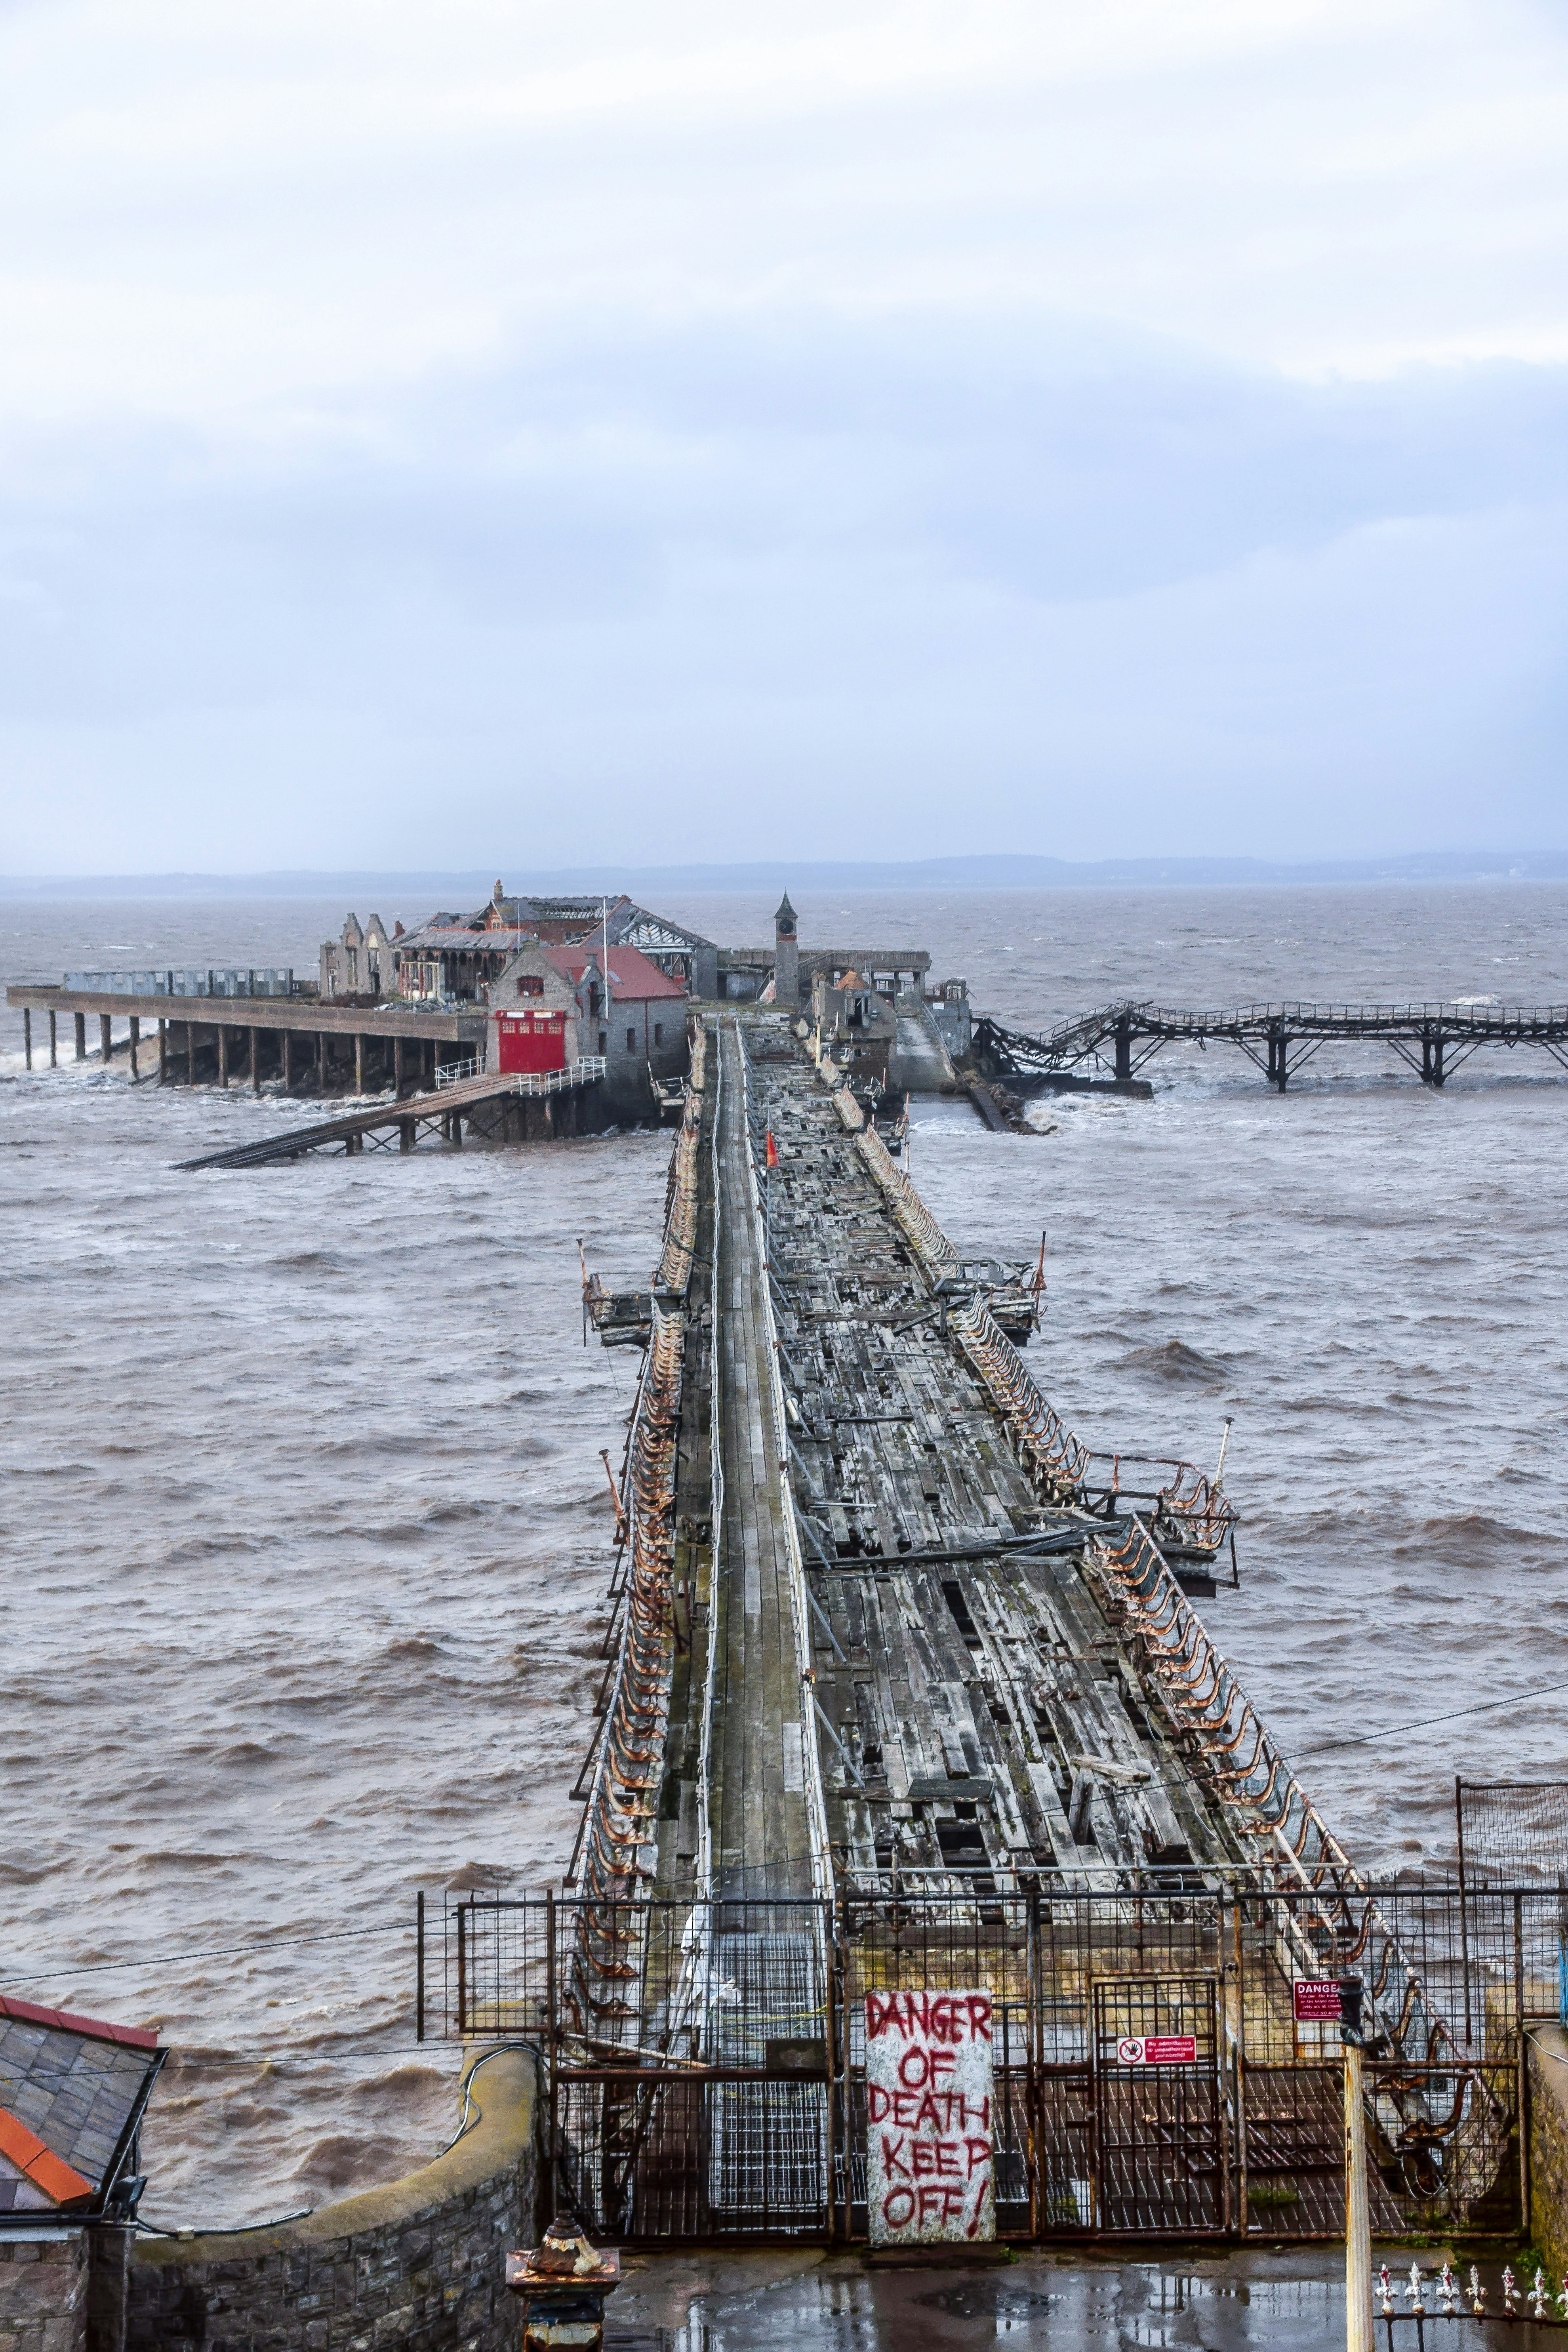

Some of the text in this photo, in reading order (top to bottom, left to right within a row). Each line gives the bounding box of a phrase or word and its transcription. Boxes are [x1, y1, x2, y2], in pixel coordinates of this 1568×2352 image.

[1298, 1984, 1339, 1993] DANGE
[866, 1991, 991, 2044] DANGER
[898, 2045, 956, 2089] OF
[868, 2081, 989, 2134] DEATH
[882, 2134, 991, 2180] KEEP
[882, 2179, 988, 2238] OFF!
